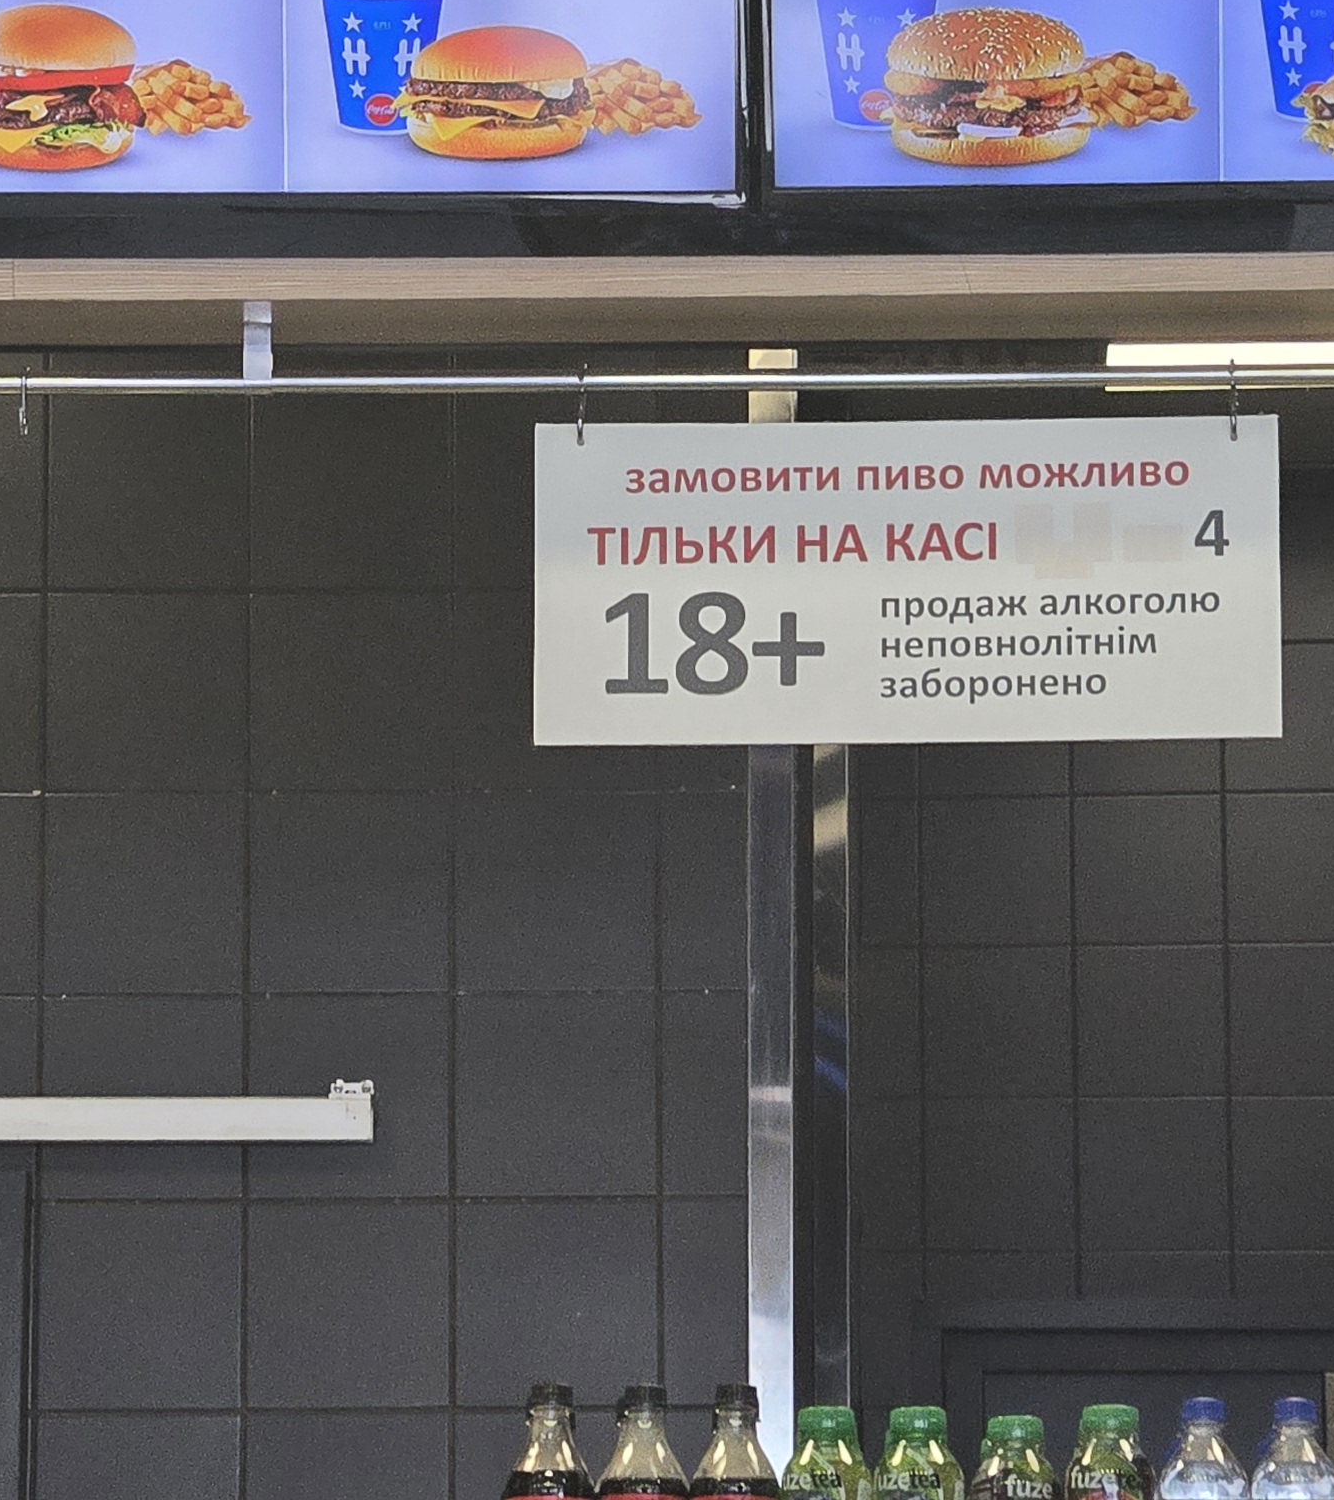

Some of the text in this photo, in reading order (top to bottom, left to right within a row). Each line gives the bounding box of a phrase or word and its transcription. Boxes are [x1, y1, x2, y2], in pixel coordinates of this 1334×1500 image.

[626, 458, 1190, 496] замовити пиво можливо
[588, 509, 1230, 566] ТІЛЬКИ НА КАСІ 4
[880, 588, 1221, 623] продаж алкоголю
[603, 590, 825, 697] 18+
[880, 629, 1157, 661] неповнолітнім
[879, 668, 1107, 702] заборонено
